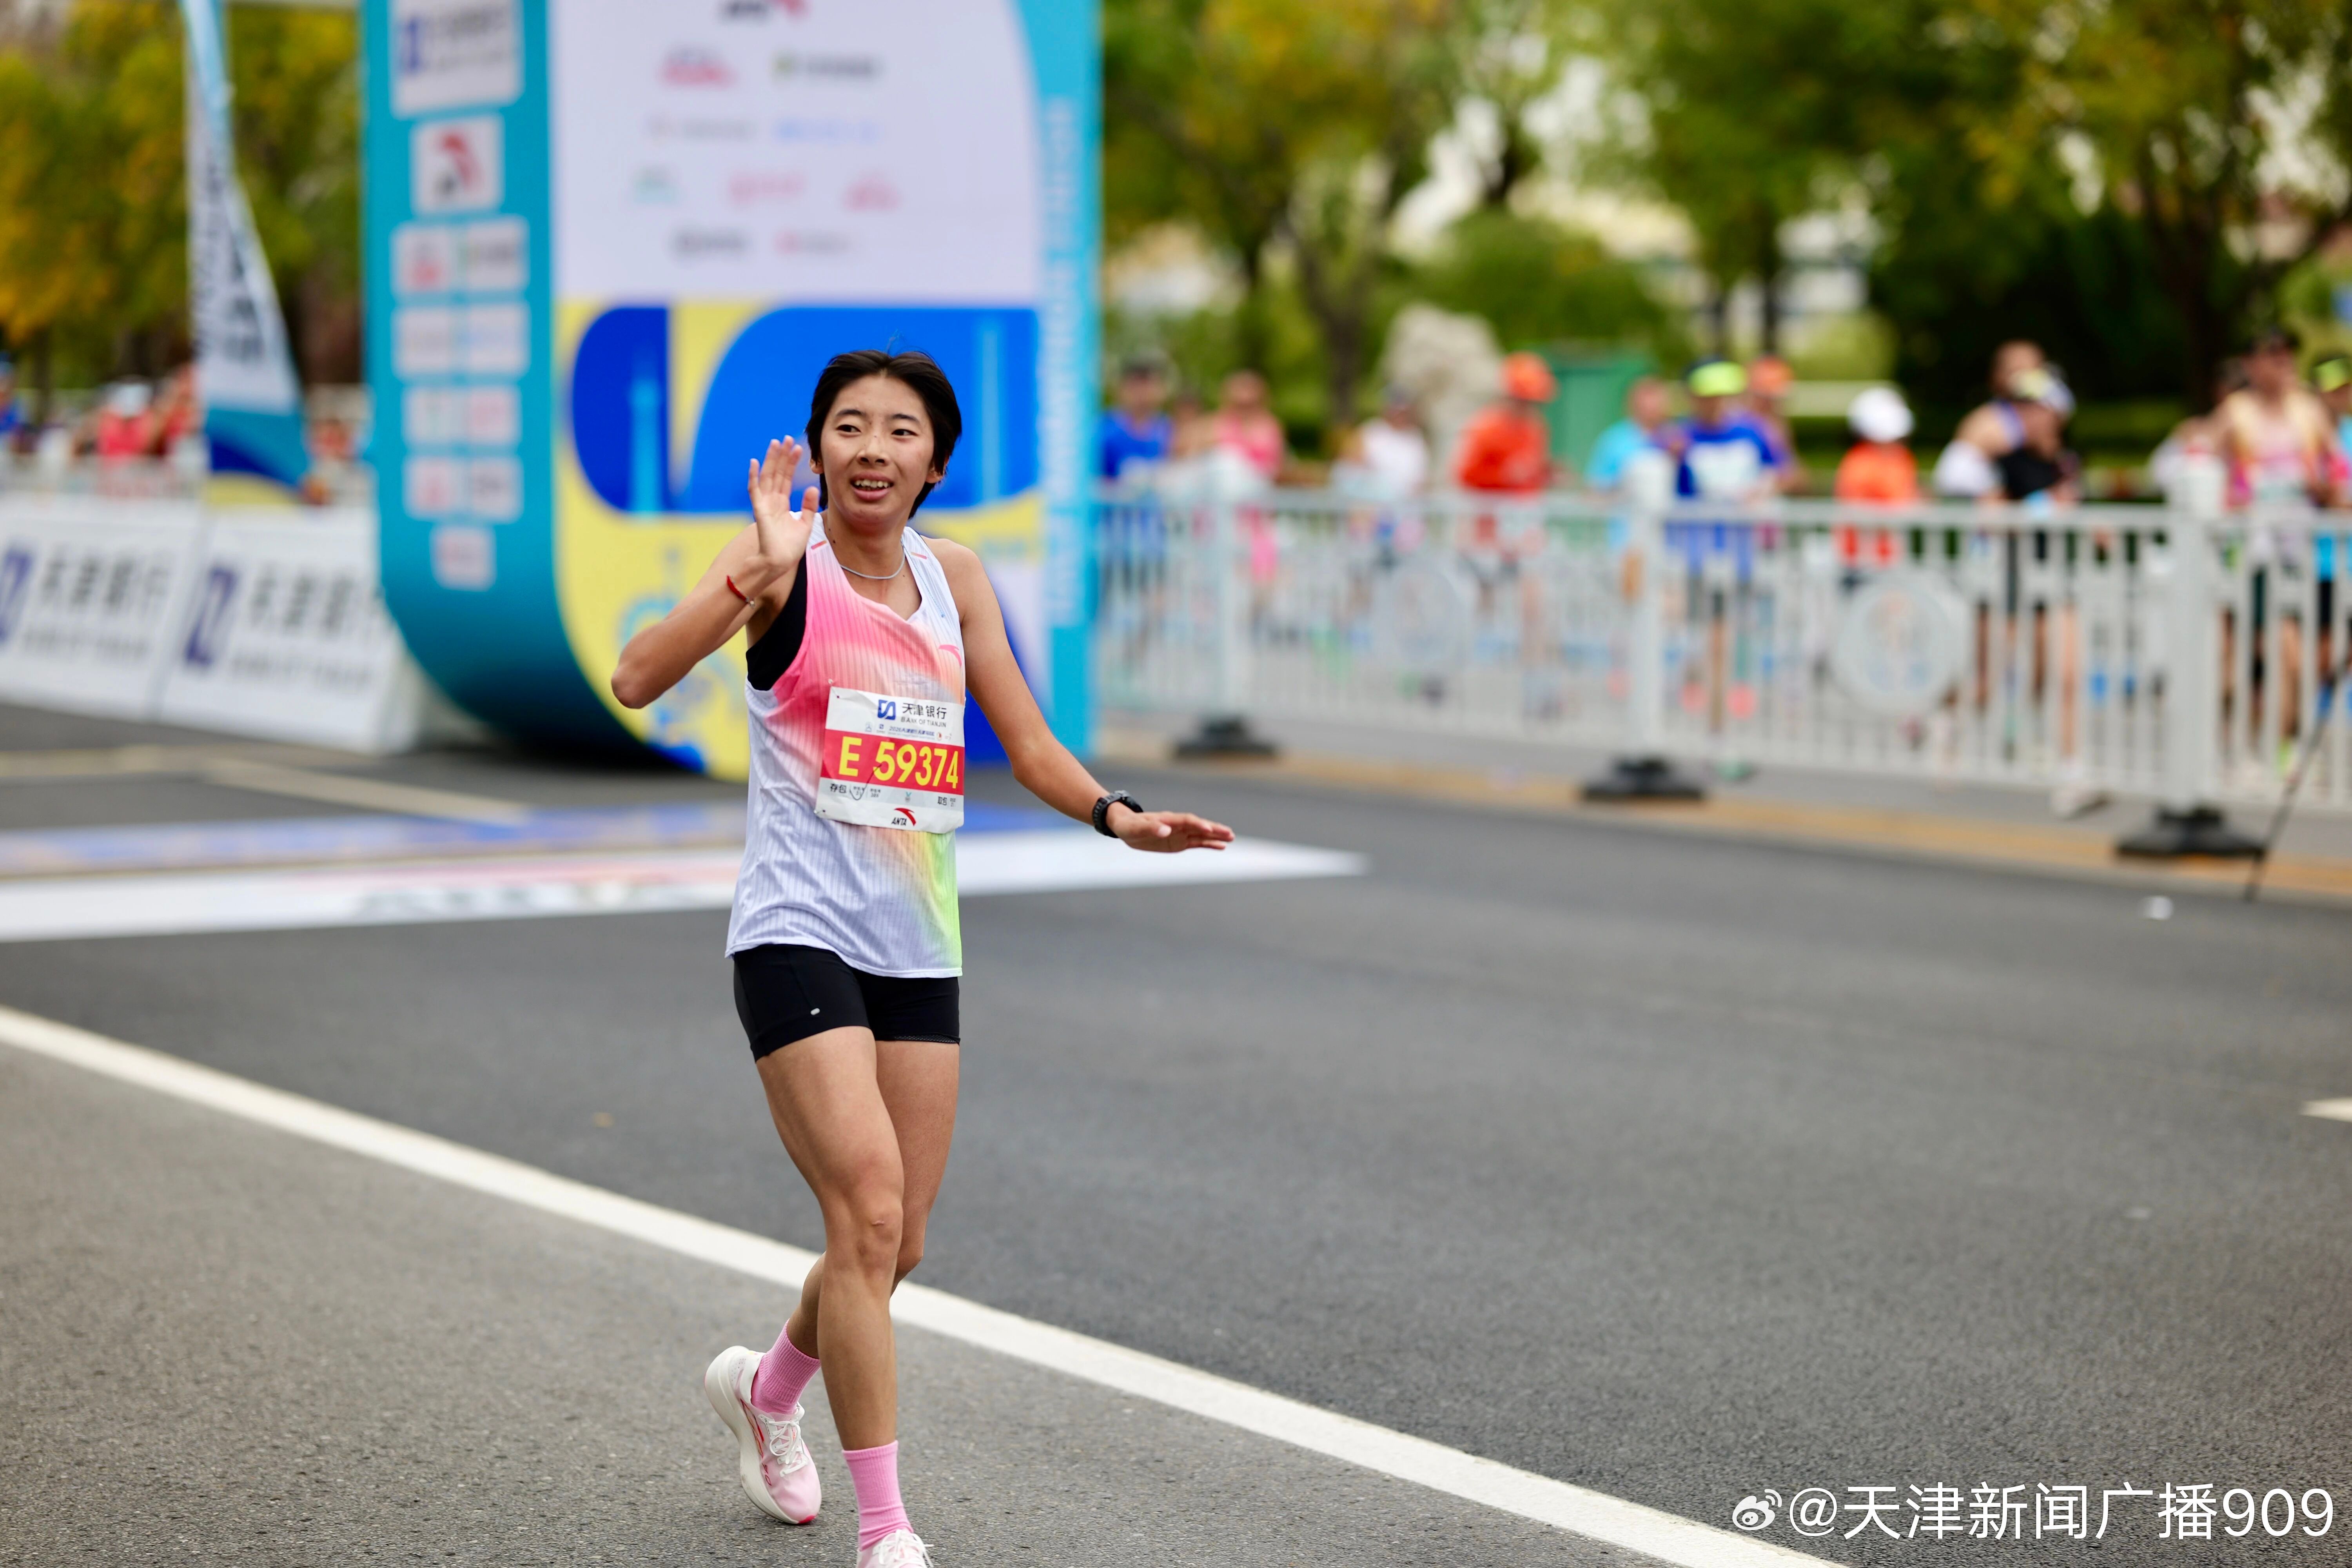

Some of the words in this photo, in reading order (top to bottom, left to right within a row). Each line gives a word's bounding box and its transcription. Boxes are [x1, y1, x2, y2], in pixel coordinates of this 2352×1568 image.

[902, 702, 947, 719] 天津银行
[927, 720, 946, 728] TIANJIN
[838, 736, 862, 777] E
[873, 741, 958, 789] 59374
[830, 783, 847, 793] 存包
[891, 817, 907, 826] ANTA
